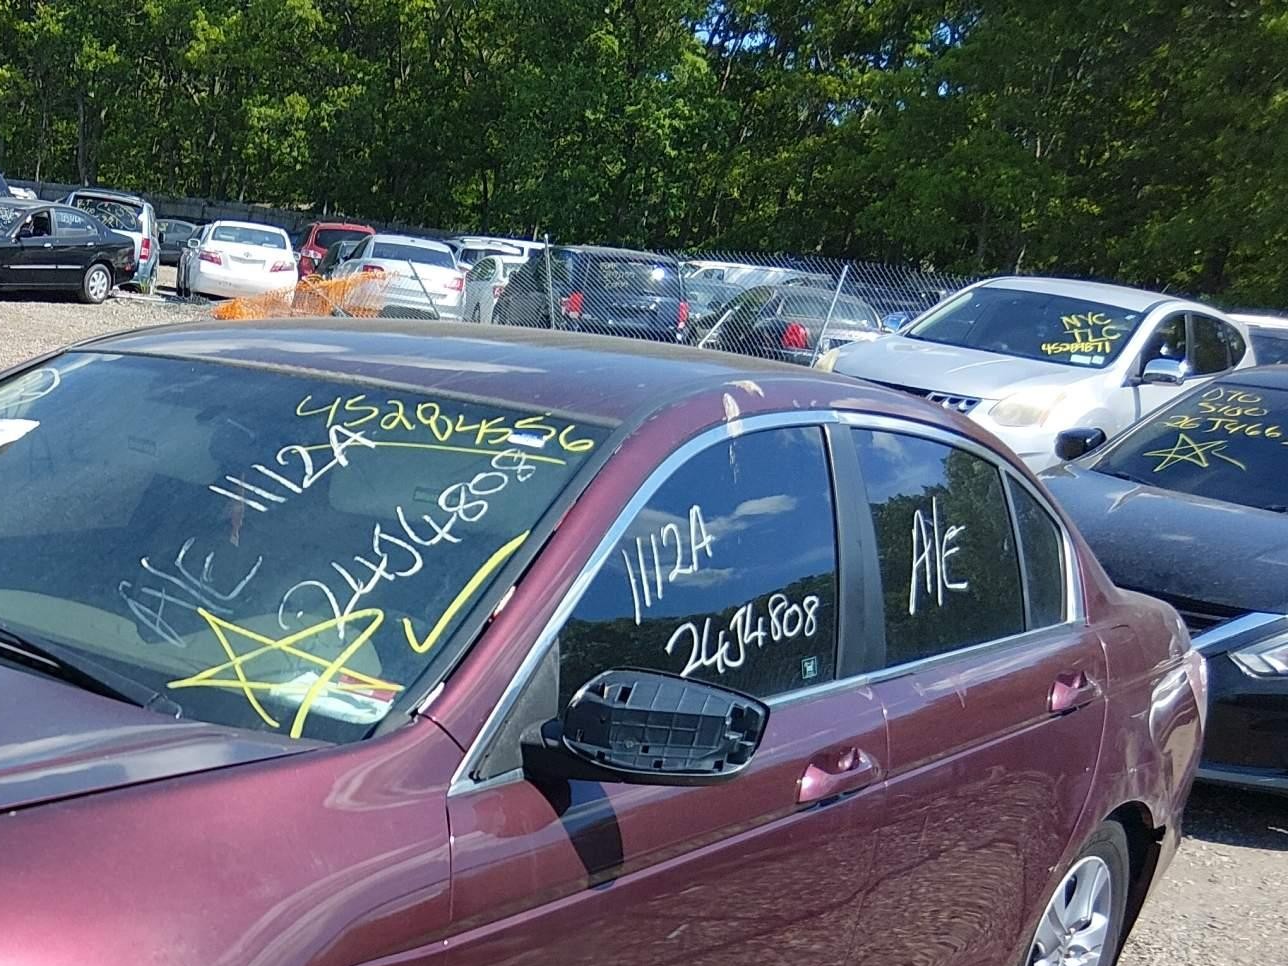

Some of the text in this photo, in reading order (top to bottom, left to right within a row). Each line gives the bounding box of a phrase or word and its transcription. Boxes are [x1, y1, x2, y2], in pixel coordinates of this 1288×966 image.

[1059, 312, 1112, 330] NYC
[1063, 326, 1121, 343] TLC
[296, 394, 595, 451] 45284556
[622, 505, 716, 625] 1112A
